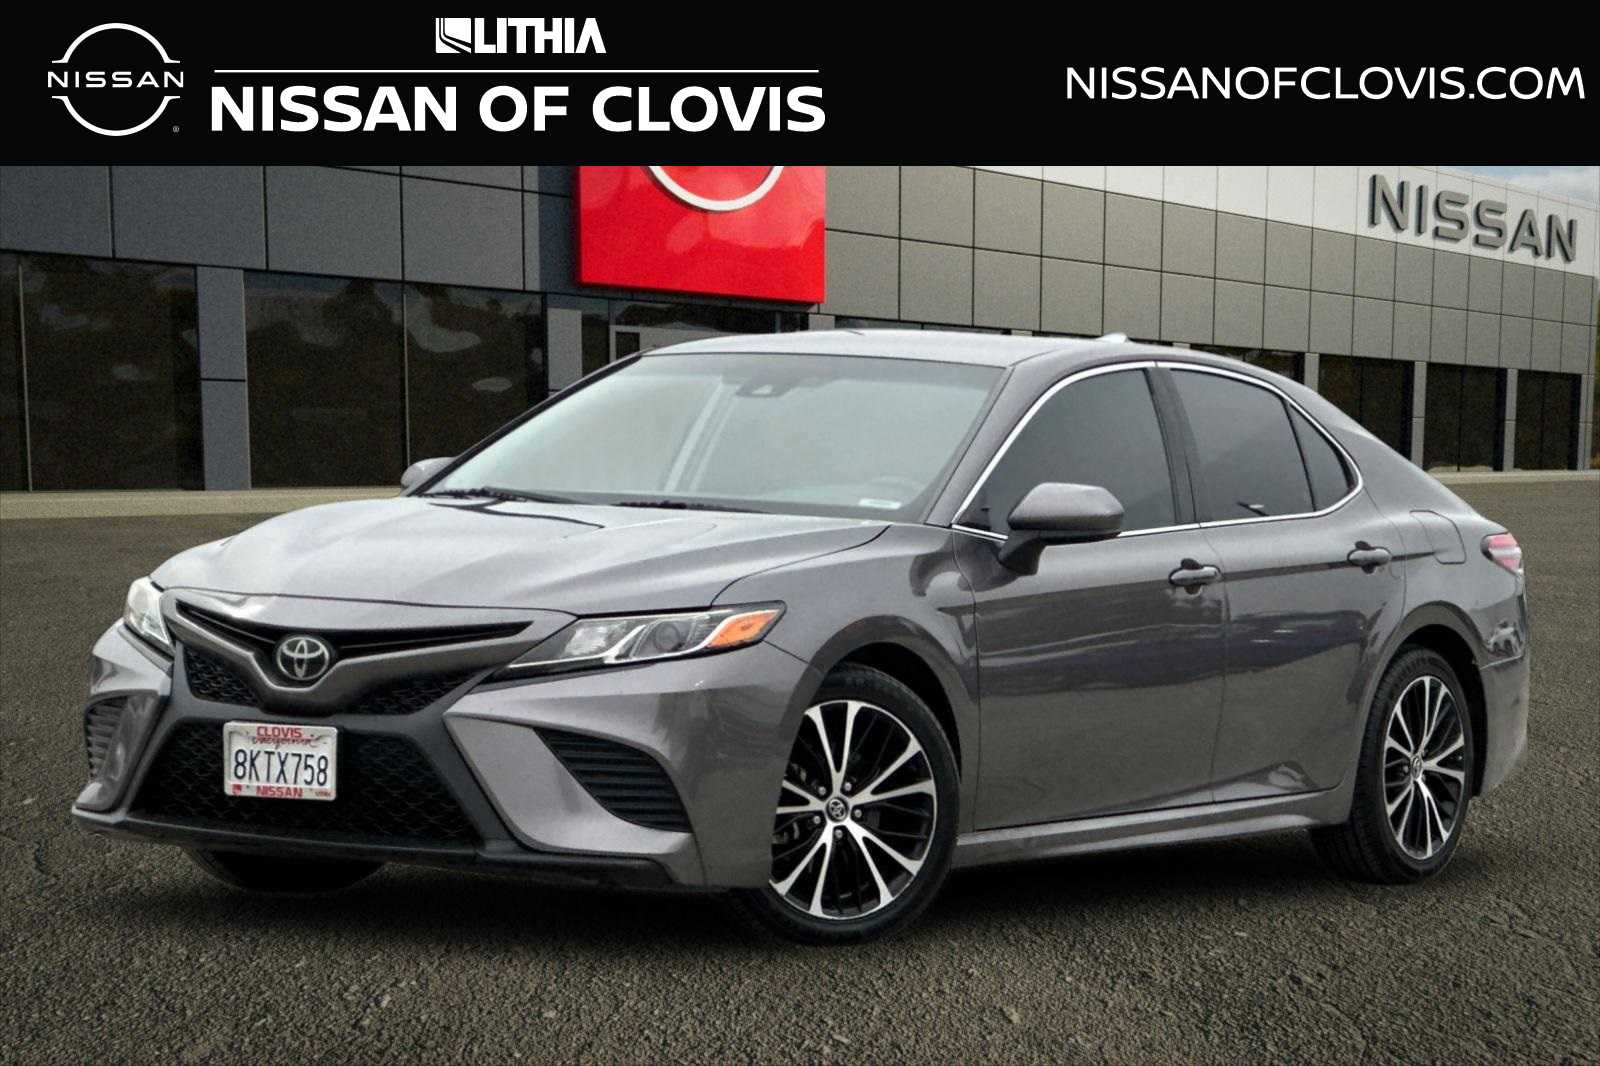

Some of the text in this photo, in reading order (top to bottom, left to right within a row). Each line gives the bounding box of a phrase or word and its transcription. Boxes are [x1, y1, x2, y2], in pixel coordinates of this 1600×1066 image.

[1368, 173, 1578, 263] NISSAN
[256, 726, 303, 738] CLOVIS
[233, 748, 329, 787] 8KTX758
[255, 785, 304, 798] NISSAN
